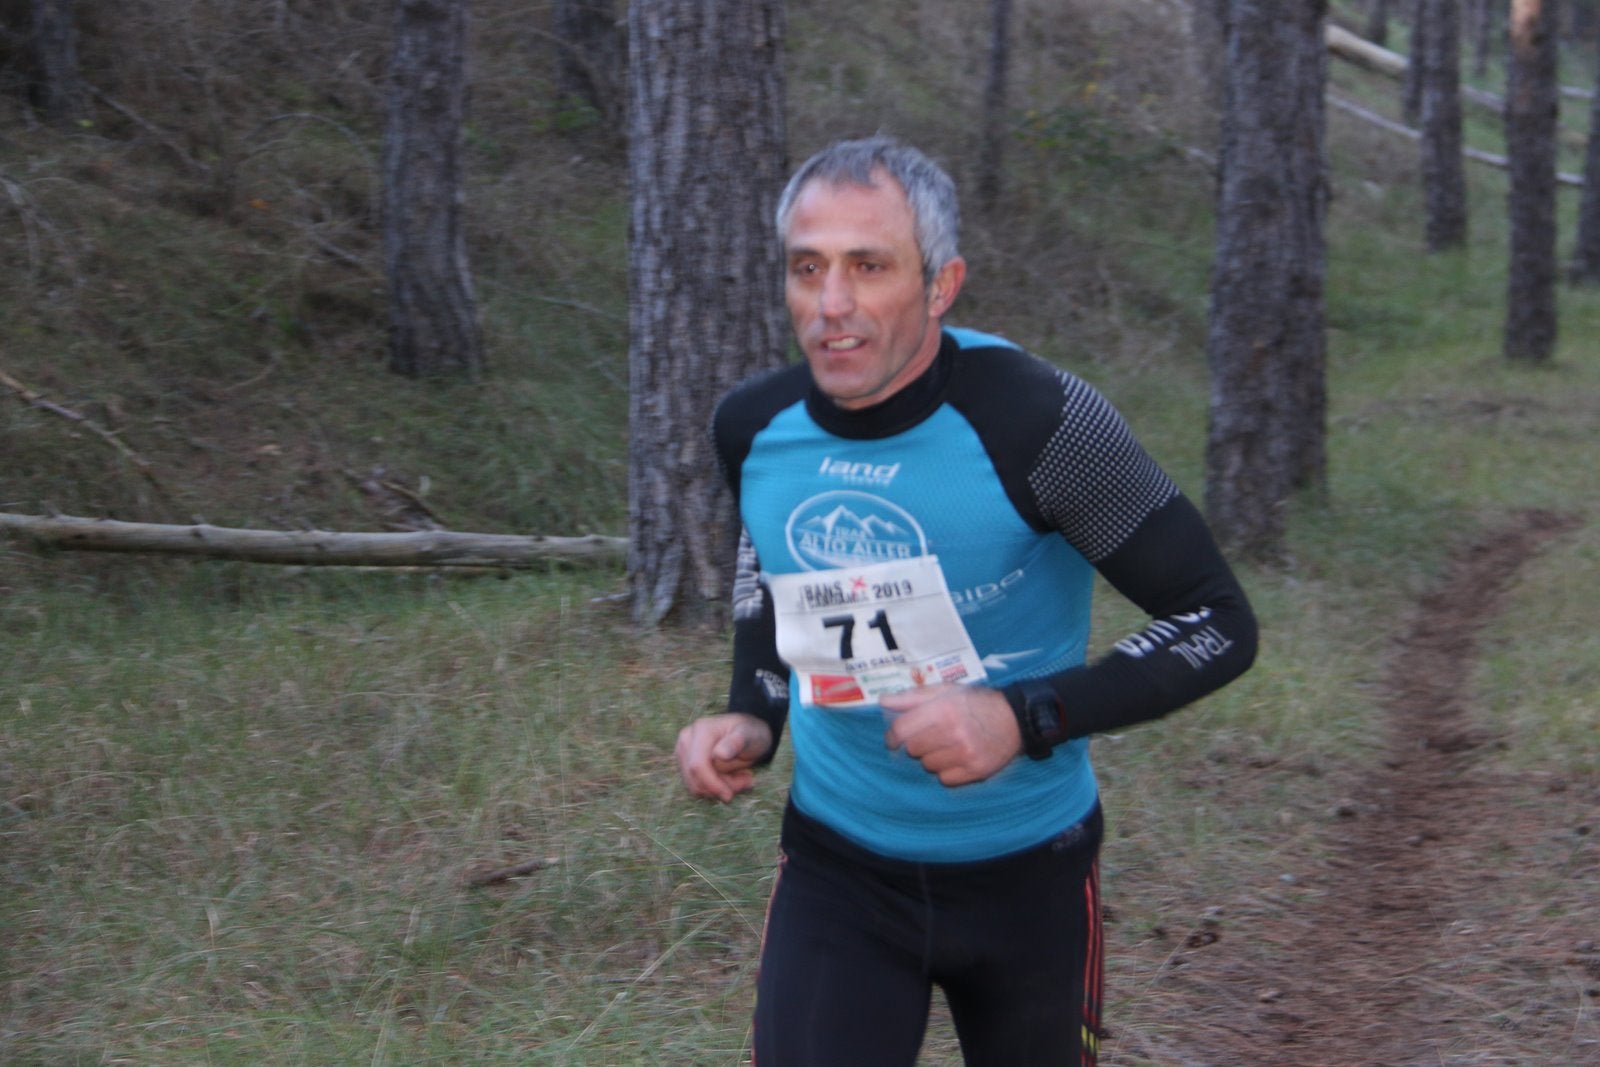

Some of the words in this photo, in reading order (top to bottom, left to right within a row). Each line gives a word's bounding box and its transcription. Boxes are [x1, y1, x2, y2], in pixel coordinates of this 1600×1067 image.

[819, 455, 900, 479] land
[799, 532, 847, 555] ALTO
[852, 539, 911, 559] ALLER
[872, 579, 913, 599] 2019
[821, 609, 899, 660] 71
[1168, 624, 1234, 670] TRAIL
